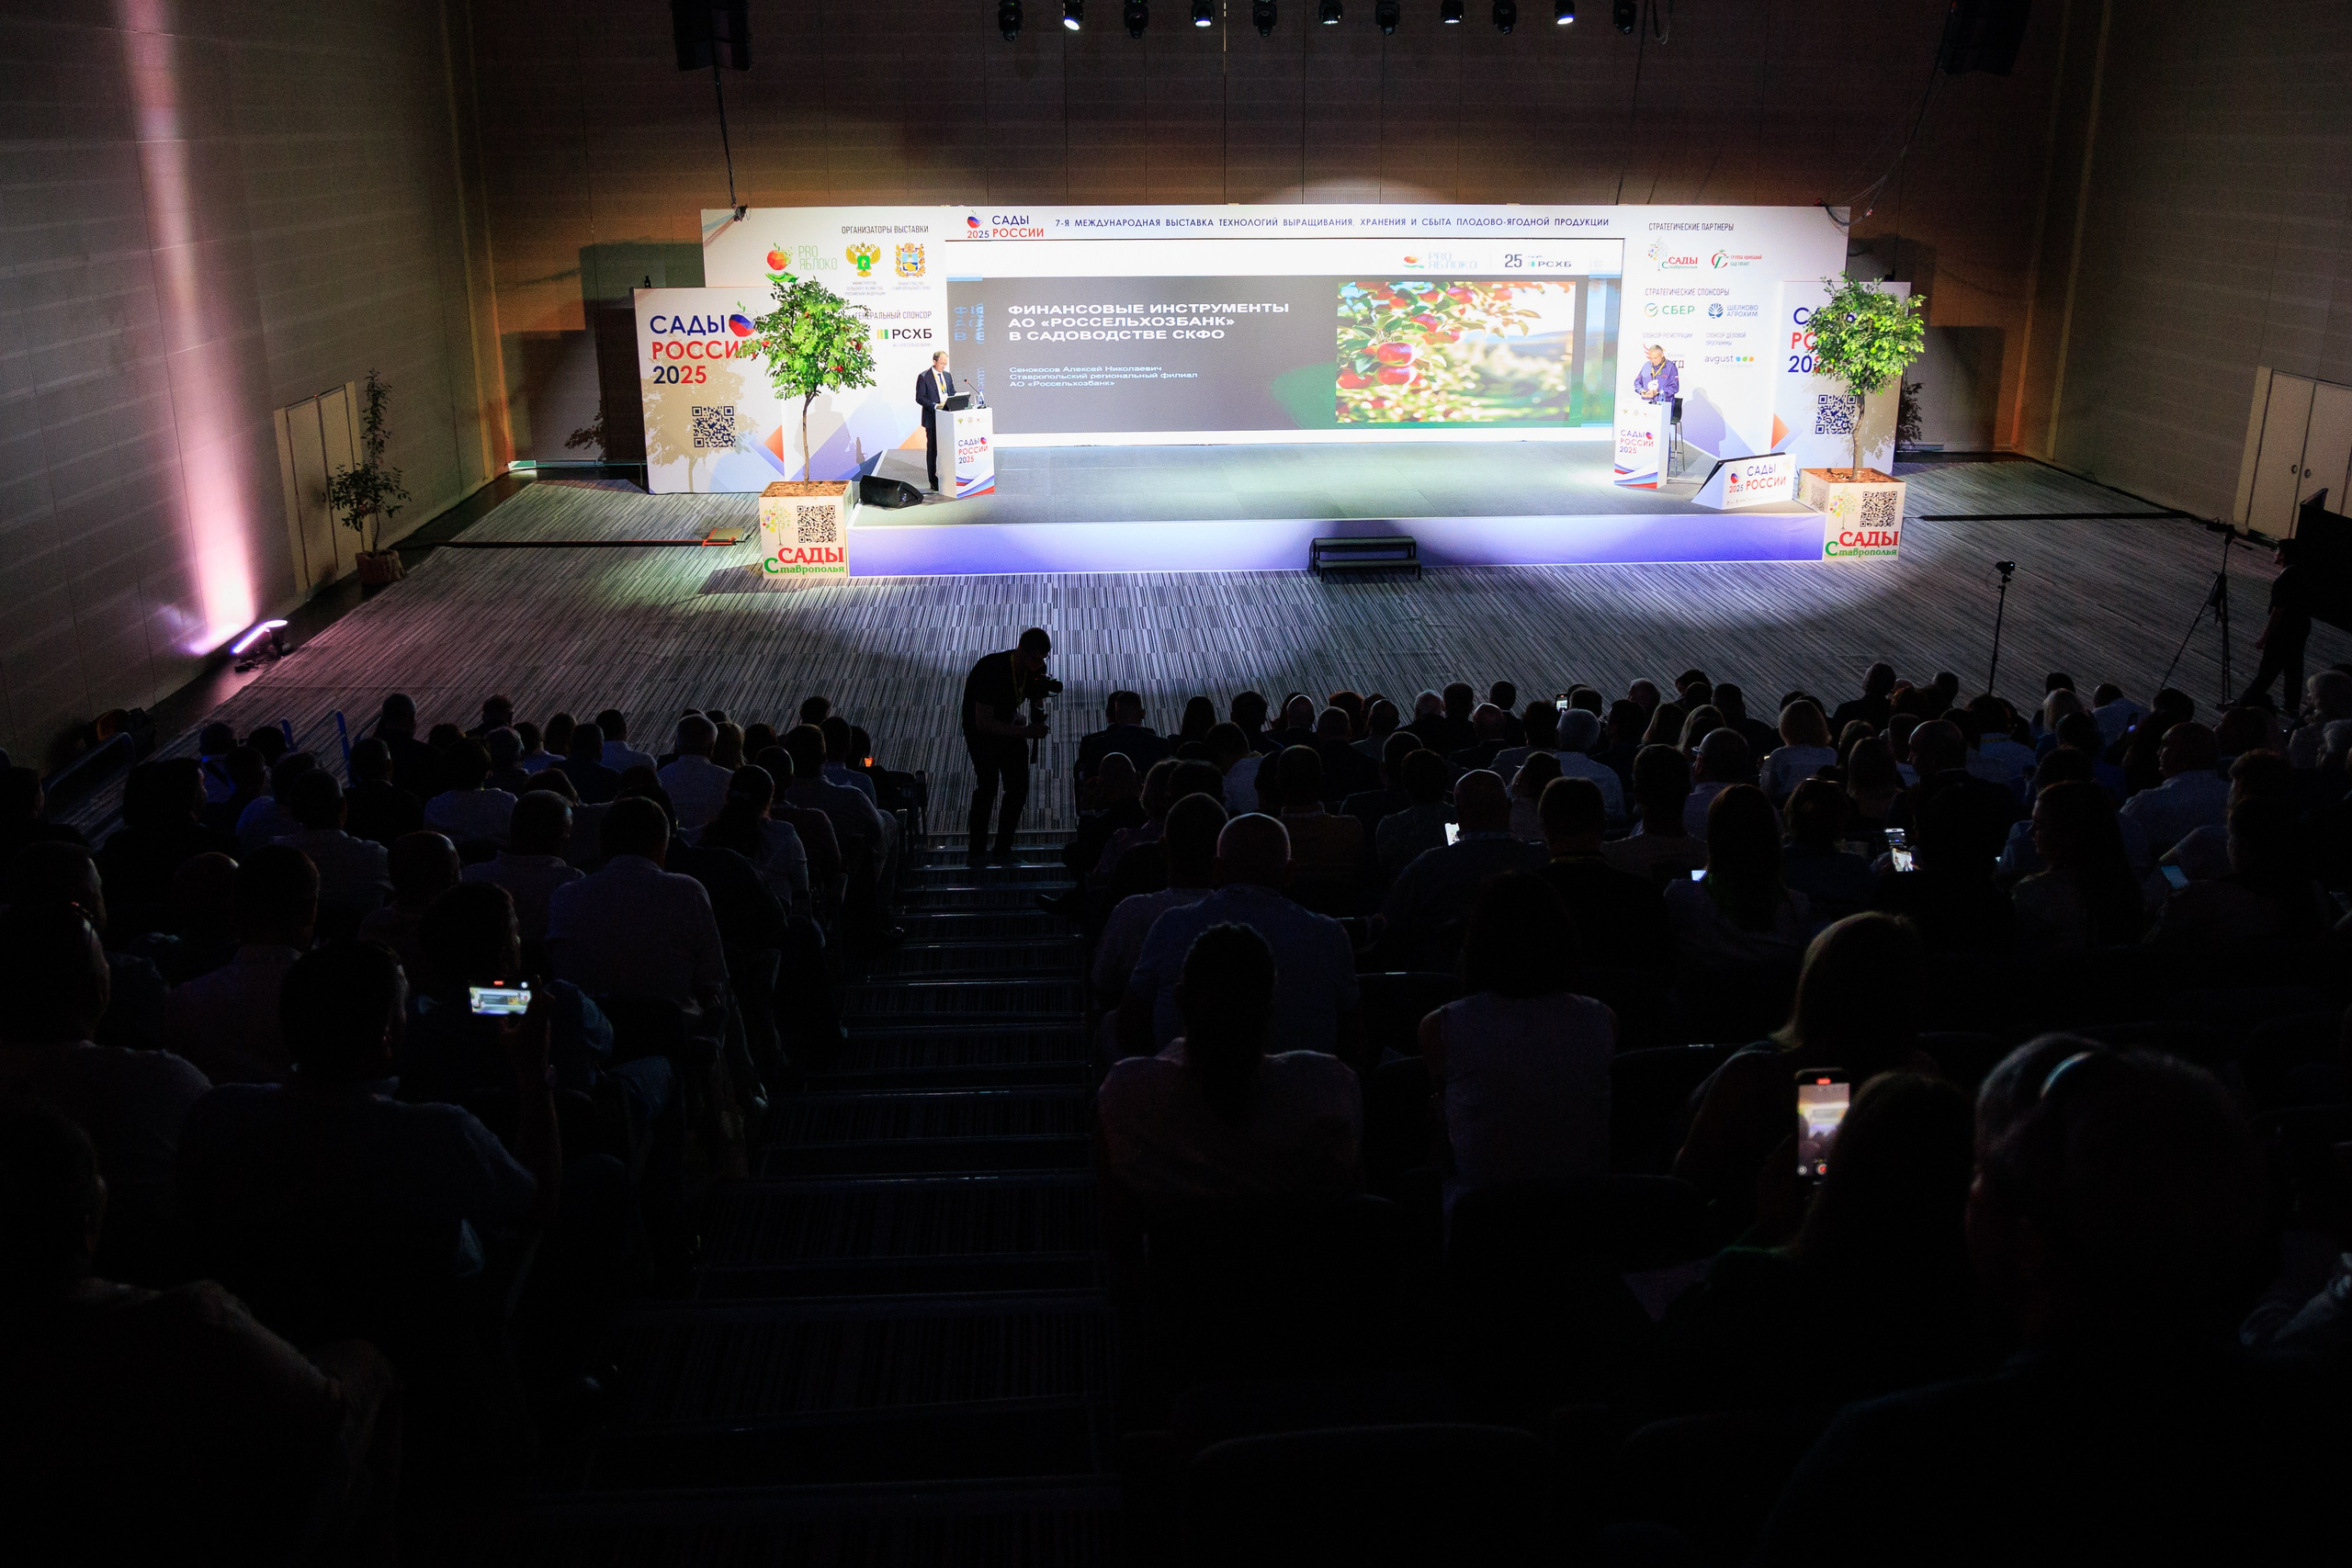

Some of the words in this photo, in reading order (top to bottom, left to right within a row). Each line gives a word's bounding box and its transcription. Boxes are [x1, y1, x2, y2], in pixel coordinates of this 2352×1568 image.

[992, 215, 1029, 226] САДЫ
[1075, 219, 1160, 227] МЕЖДУНАРОДНАЯ
[1166, 219, 1214, 227] ВЫСТАВКА
[1219, 217, 1278, 227] ТЕХНОЛОГИЙ
[1422, 218, 1452, 226] СБЫТА
[1457, 217, 1550, 227] ПЛОДОВО-ЯГОДНОЙ
[1555, 219, 1609, 227] ПРОДУКЦИИ
[842, 226, 892, 234] ОРГАНИЗАТОРЫ
[894, 225, 929, 233] ВЫСТАВКИ
[1648, 222, 1700, 231] СТРАТЕГИЧЕСКИЕ
[1702, 222, 1734, 231] ПАРТНЕРЫ
[967, 231, 989, 239] 2025
[992, 228, 1044, 238] РОССИИ
[798, 245, 819, 258] PRO
[799, 258, 838, 271] ЯБЛОКО
[1504, 254, 1522, 267] 25
[1668, 256, 1698, 265] САДЫ
[1008, 304, 1145, 315] ФИНАНСОВЫЕ
[1149, 303, 1289, 314] ИНСТРУМЕНТЫ
[1662, 305, 1695, 315] СБЕР
[902, 310, 933, 320] СПОНСОР
[650, 315, 726, 336] САДЫ
[1008, 318, 1035, 328] АО
[1040, 317, 1235, 327] «РОССЕЛЬХОЗБАНК»
[891, 328, 933, 340] РСХБ
[1009, 332, 1022, 341] В
[1026, 330, 1167, 342] САДОВОДСТВЕ
[1171, 329, 1226, 340] СКФО
[1704, 355, 1734, 364] avgust
[1063, 364, 1102, 372] Алексей
[653, 365, 707, 384] 2025
[1010, 372, 1088, 381] Ставропольский
[1091, 372, 1158, 380] региональный
[1160, 371, 1198, 379] филиал
[1028, 379, 1115, 388] «Россельхозбанк»
[1620, 429, 1645, 438] САДЫ
[958, 437, 980, 447] САДЫ
[1620, 437, 1654, 447] РОССИИ
[958, 446, 989, 456] РОССИИ
[958, 456, 975, 465] 2025
[1747, 463, 1777, 477] САДЫ
[1728, 483, 1744, 493] 2025
[1746, 475, 1787, 491] РОССИИ
[1839, 531, 1899, 548] САДЫ
[1825, 540, 1897, 558] Ставрополья
[777, 547, 844, 565] САДЫ
[763, 558, 844, 575] Ставрополья
